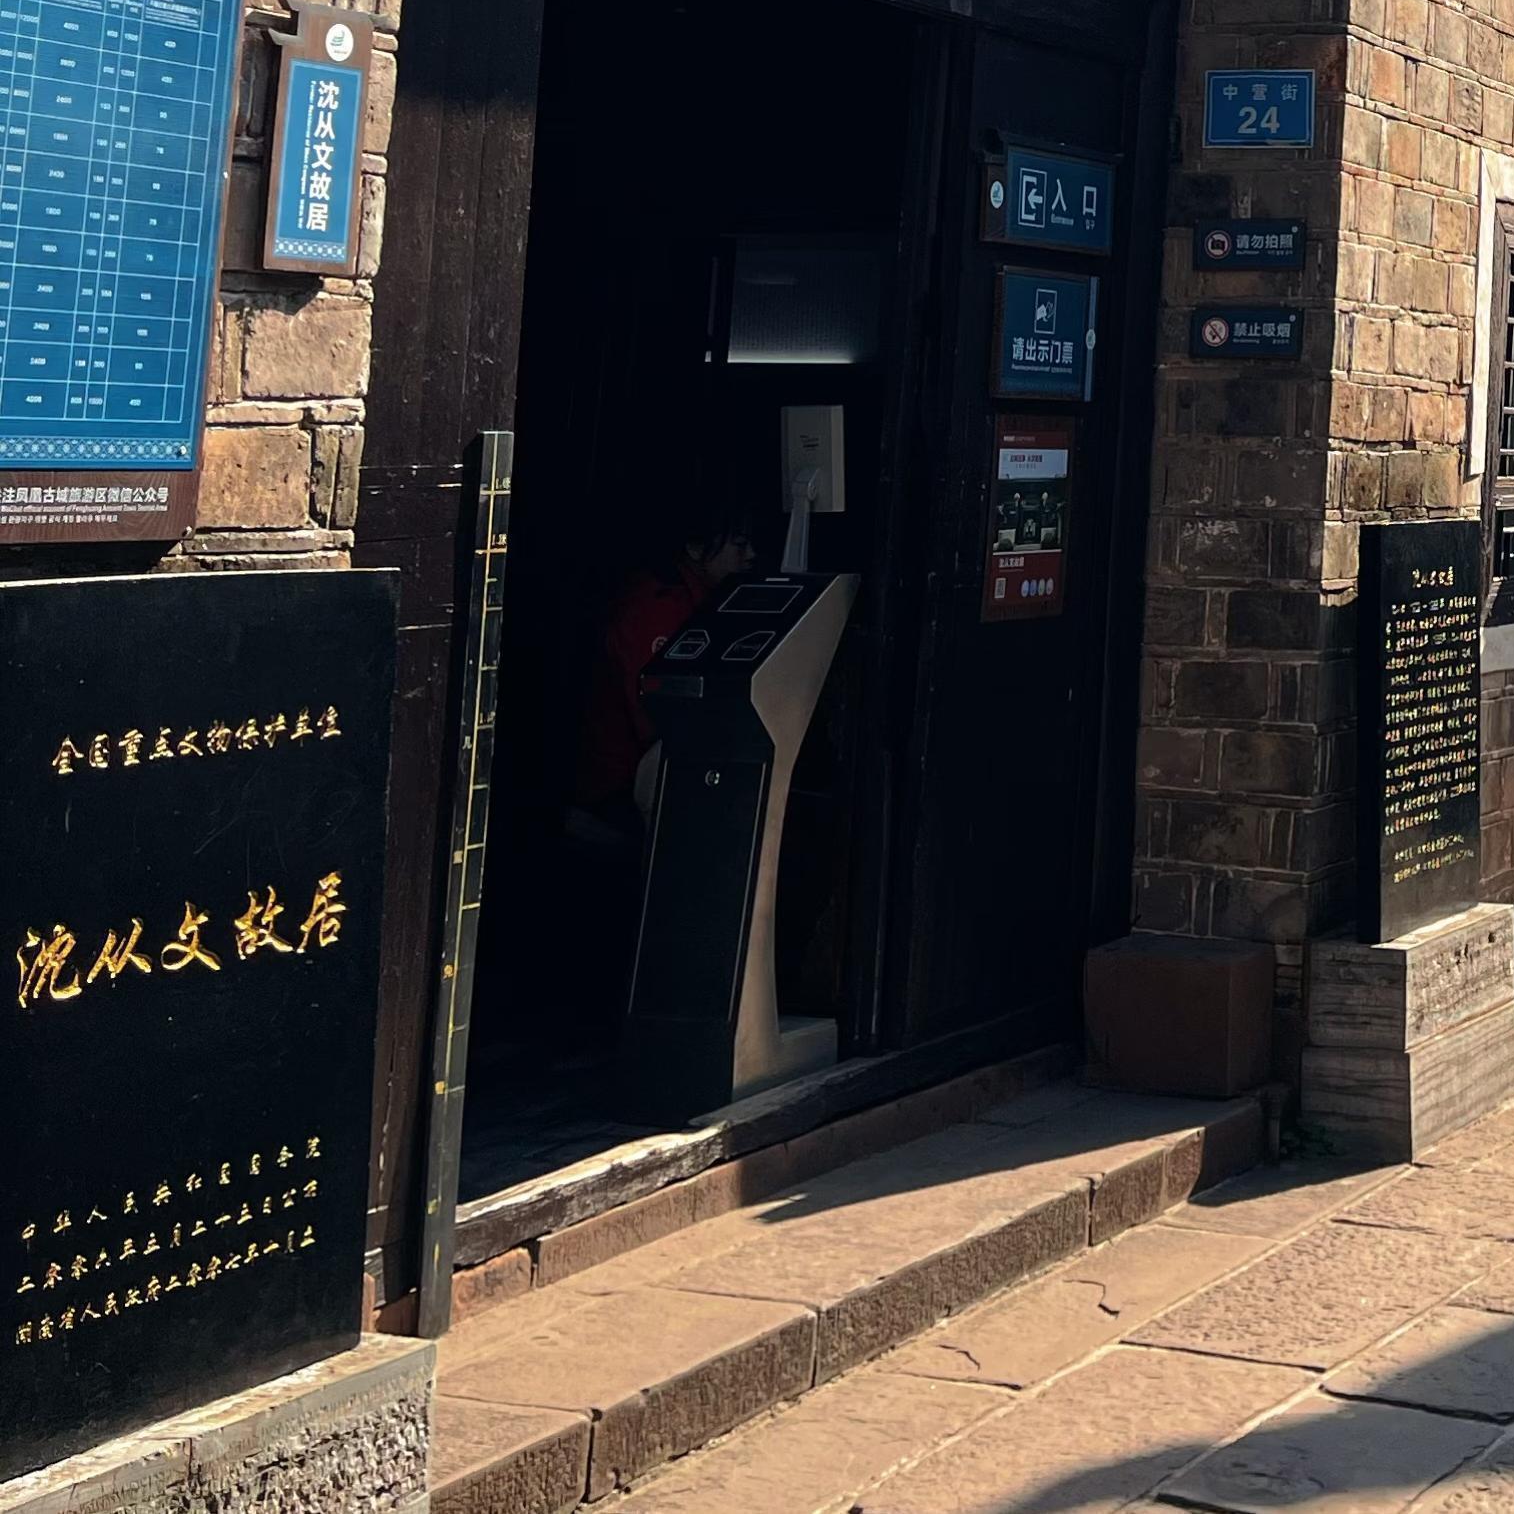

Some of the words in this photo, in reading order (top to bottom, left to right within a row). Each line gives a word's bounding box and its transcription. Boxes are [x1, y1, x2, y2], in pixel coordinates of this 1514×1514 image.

[1223, 83, 1299, 101] 中营街
[1237, 106, 1280, 135] 24
[306, 80, 340, 232] 沈从文故居
[1051, 177, 1097, 217] 入口
[1236, 233, 1294, 249] 请勿拍照
[1232, 322, 1291, 338] 禁止吸烟
[1012, 337, 1074, 364] 请出示门票
[0, 487, 169, 503] 注凤凰古城旅游区微信公众号
[52, 705, 342, 774] 全国重点文物保护单位
[16, 871, 348, 1008] 沈从文故居
